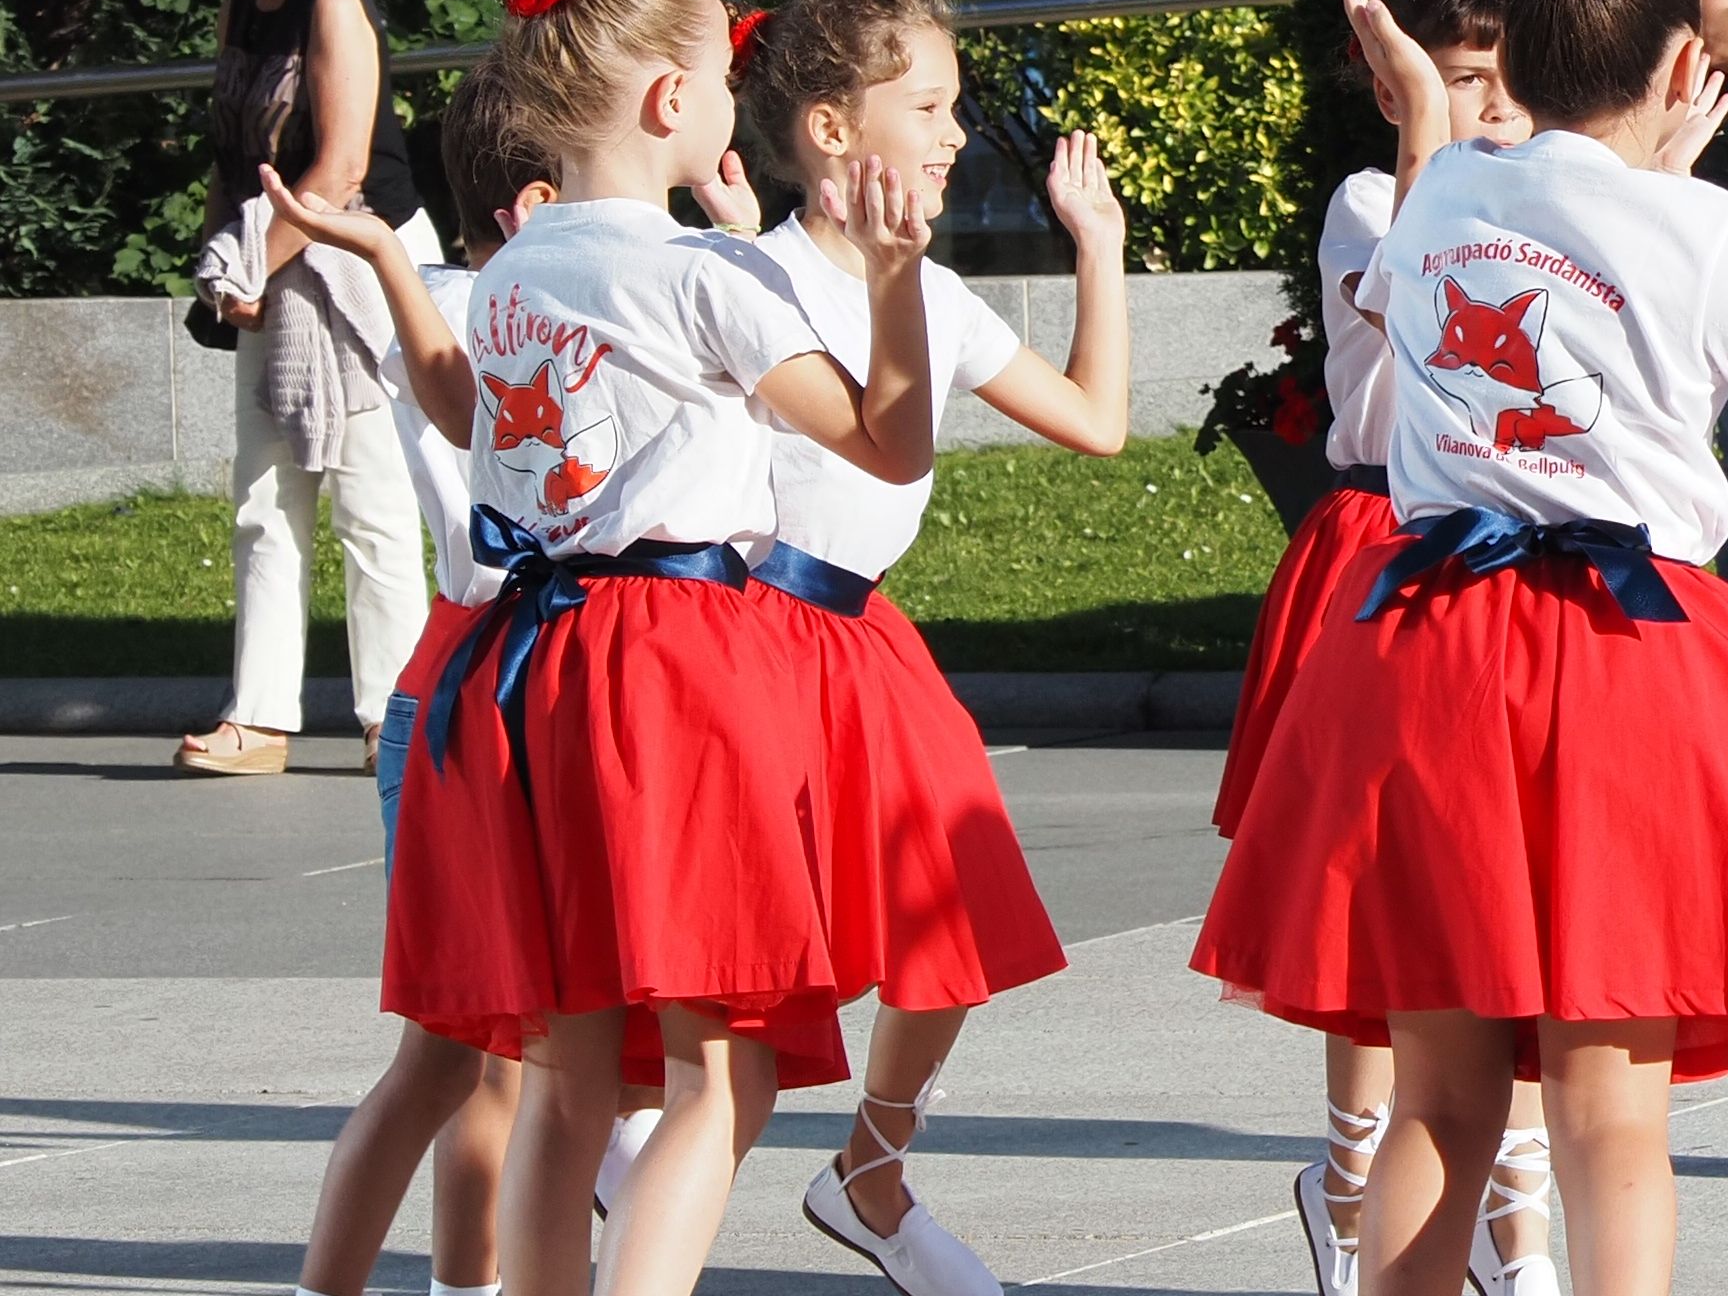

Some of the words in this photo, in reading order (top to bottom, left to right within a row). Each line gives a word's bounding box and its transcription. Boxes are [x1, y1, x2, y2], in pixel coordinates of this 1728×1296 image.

[1421, 238, 1513, 278] Agrupació
[1514, 242, 1626, 314] Sardanista
[1435, 433, 1492, 461] Vilanova
[1517, 457, 1586, 479] Bellpuig
